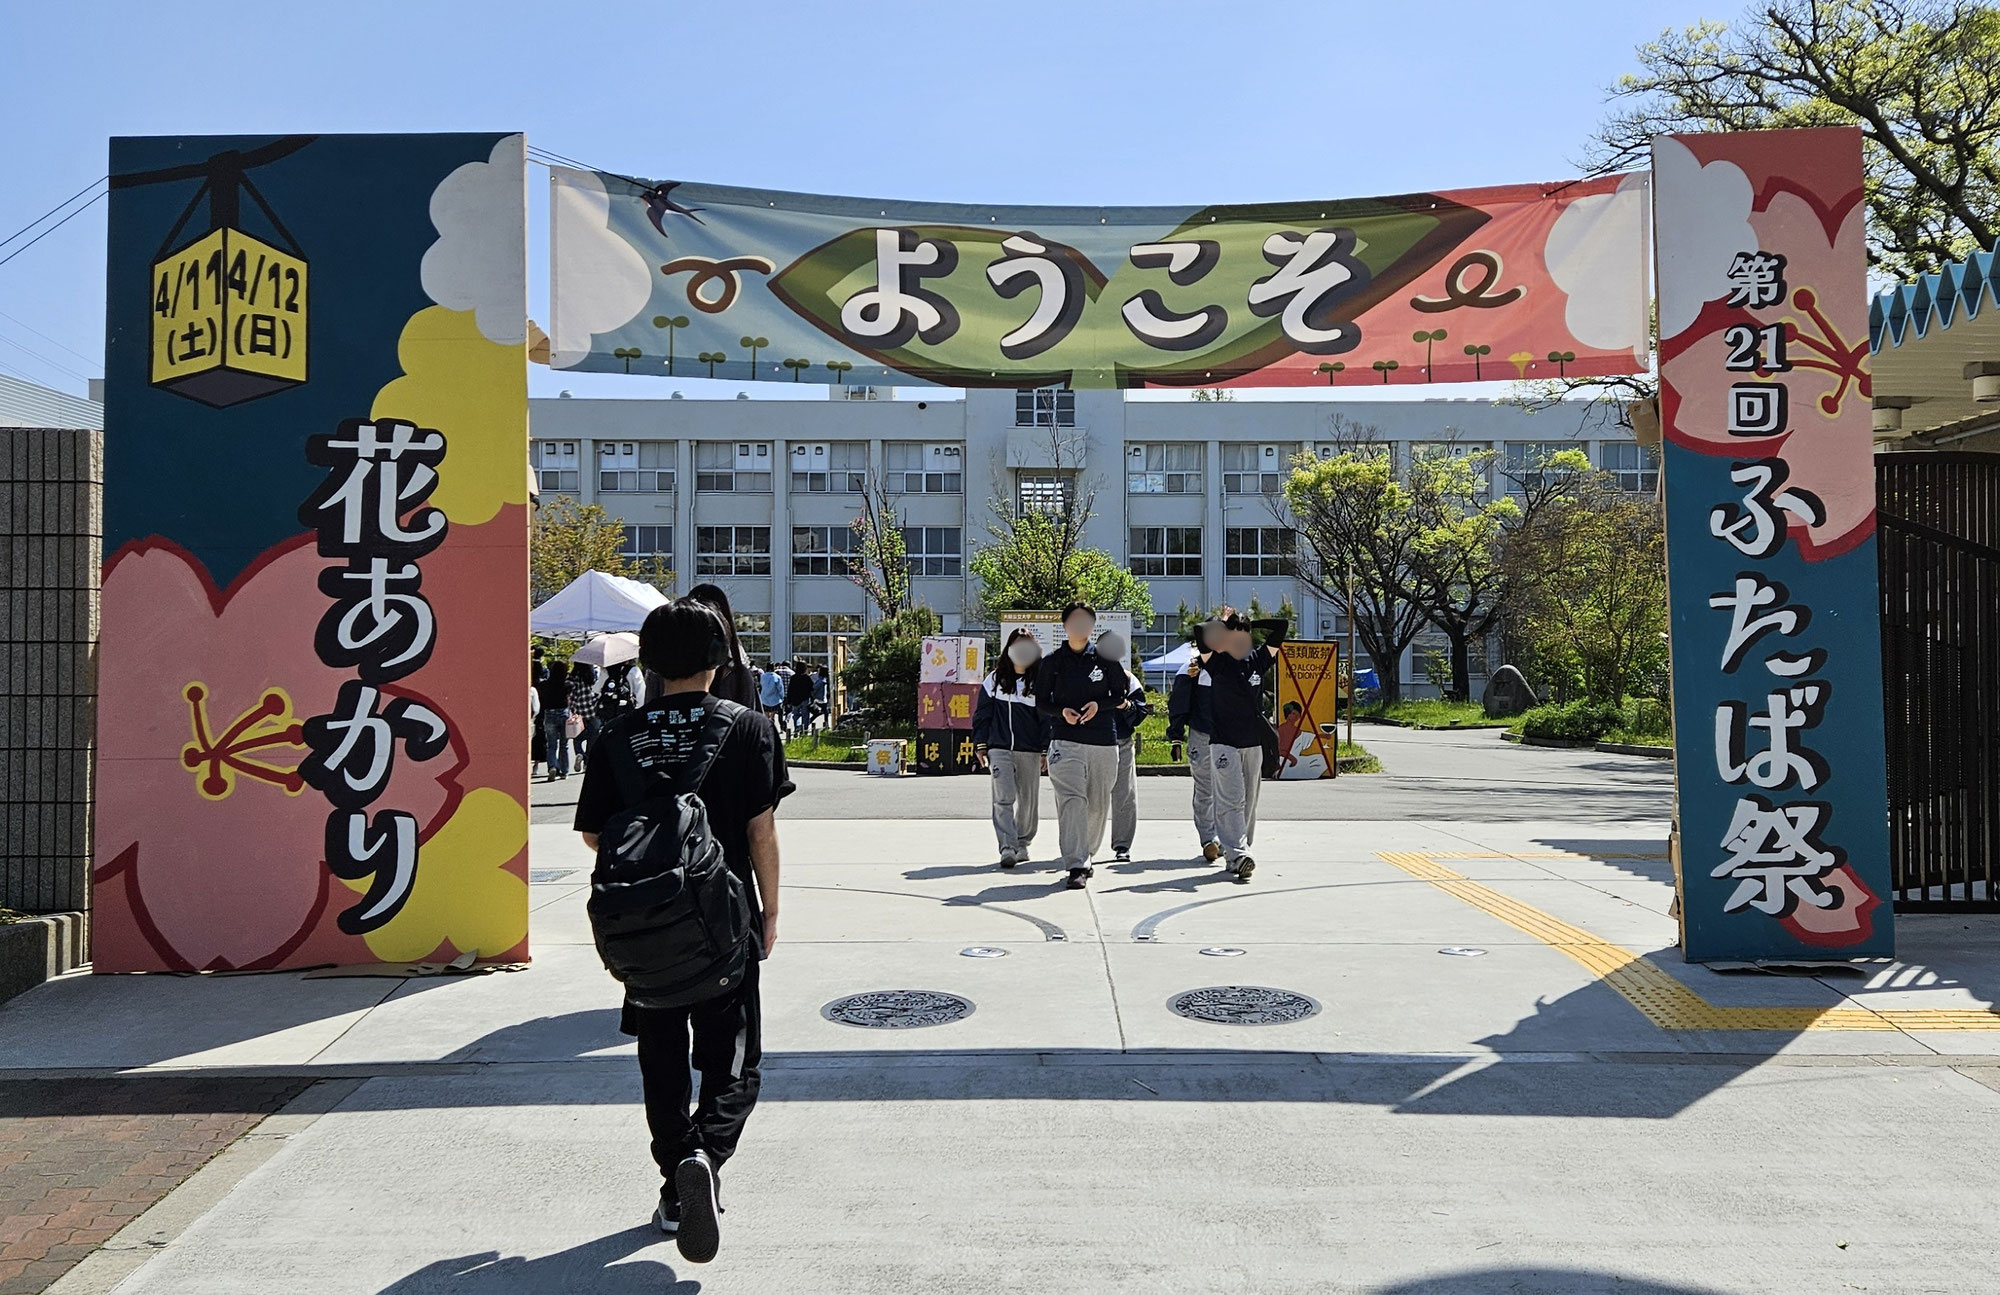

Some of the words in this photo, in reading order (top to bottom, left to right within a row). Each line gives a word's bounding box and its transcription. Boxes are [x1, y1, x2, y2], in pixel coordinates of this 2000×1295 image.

[155, 248, 222, 319] 4/11
[228, 248, 299, 314] 4/12
[841, 228, 1352, 347] ようこそ
[167, 316, 218, 366] (土)
[234, 313, 292, 359] (日)
[1724, 256, 1783, 433] 第21回
[318, 424, 447, 920] 花あかり
[1709, 465, 1836, 915] ふたば祭
